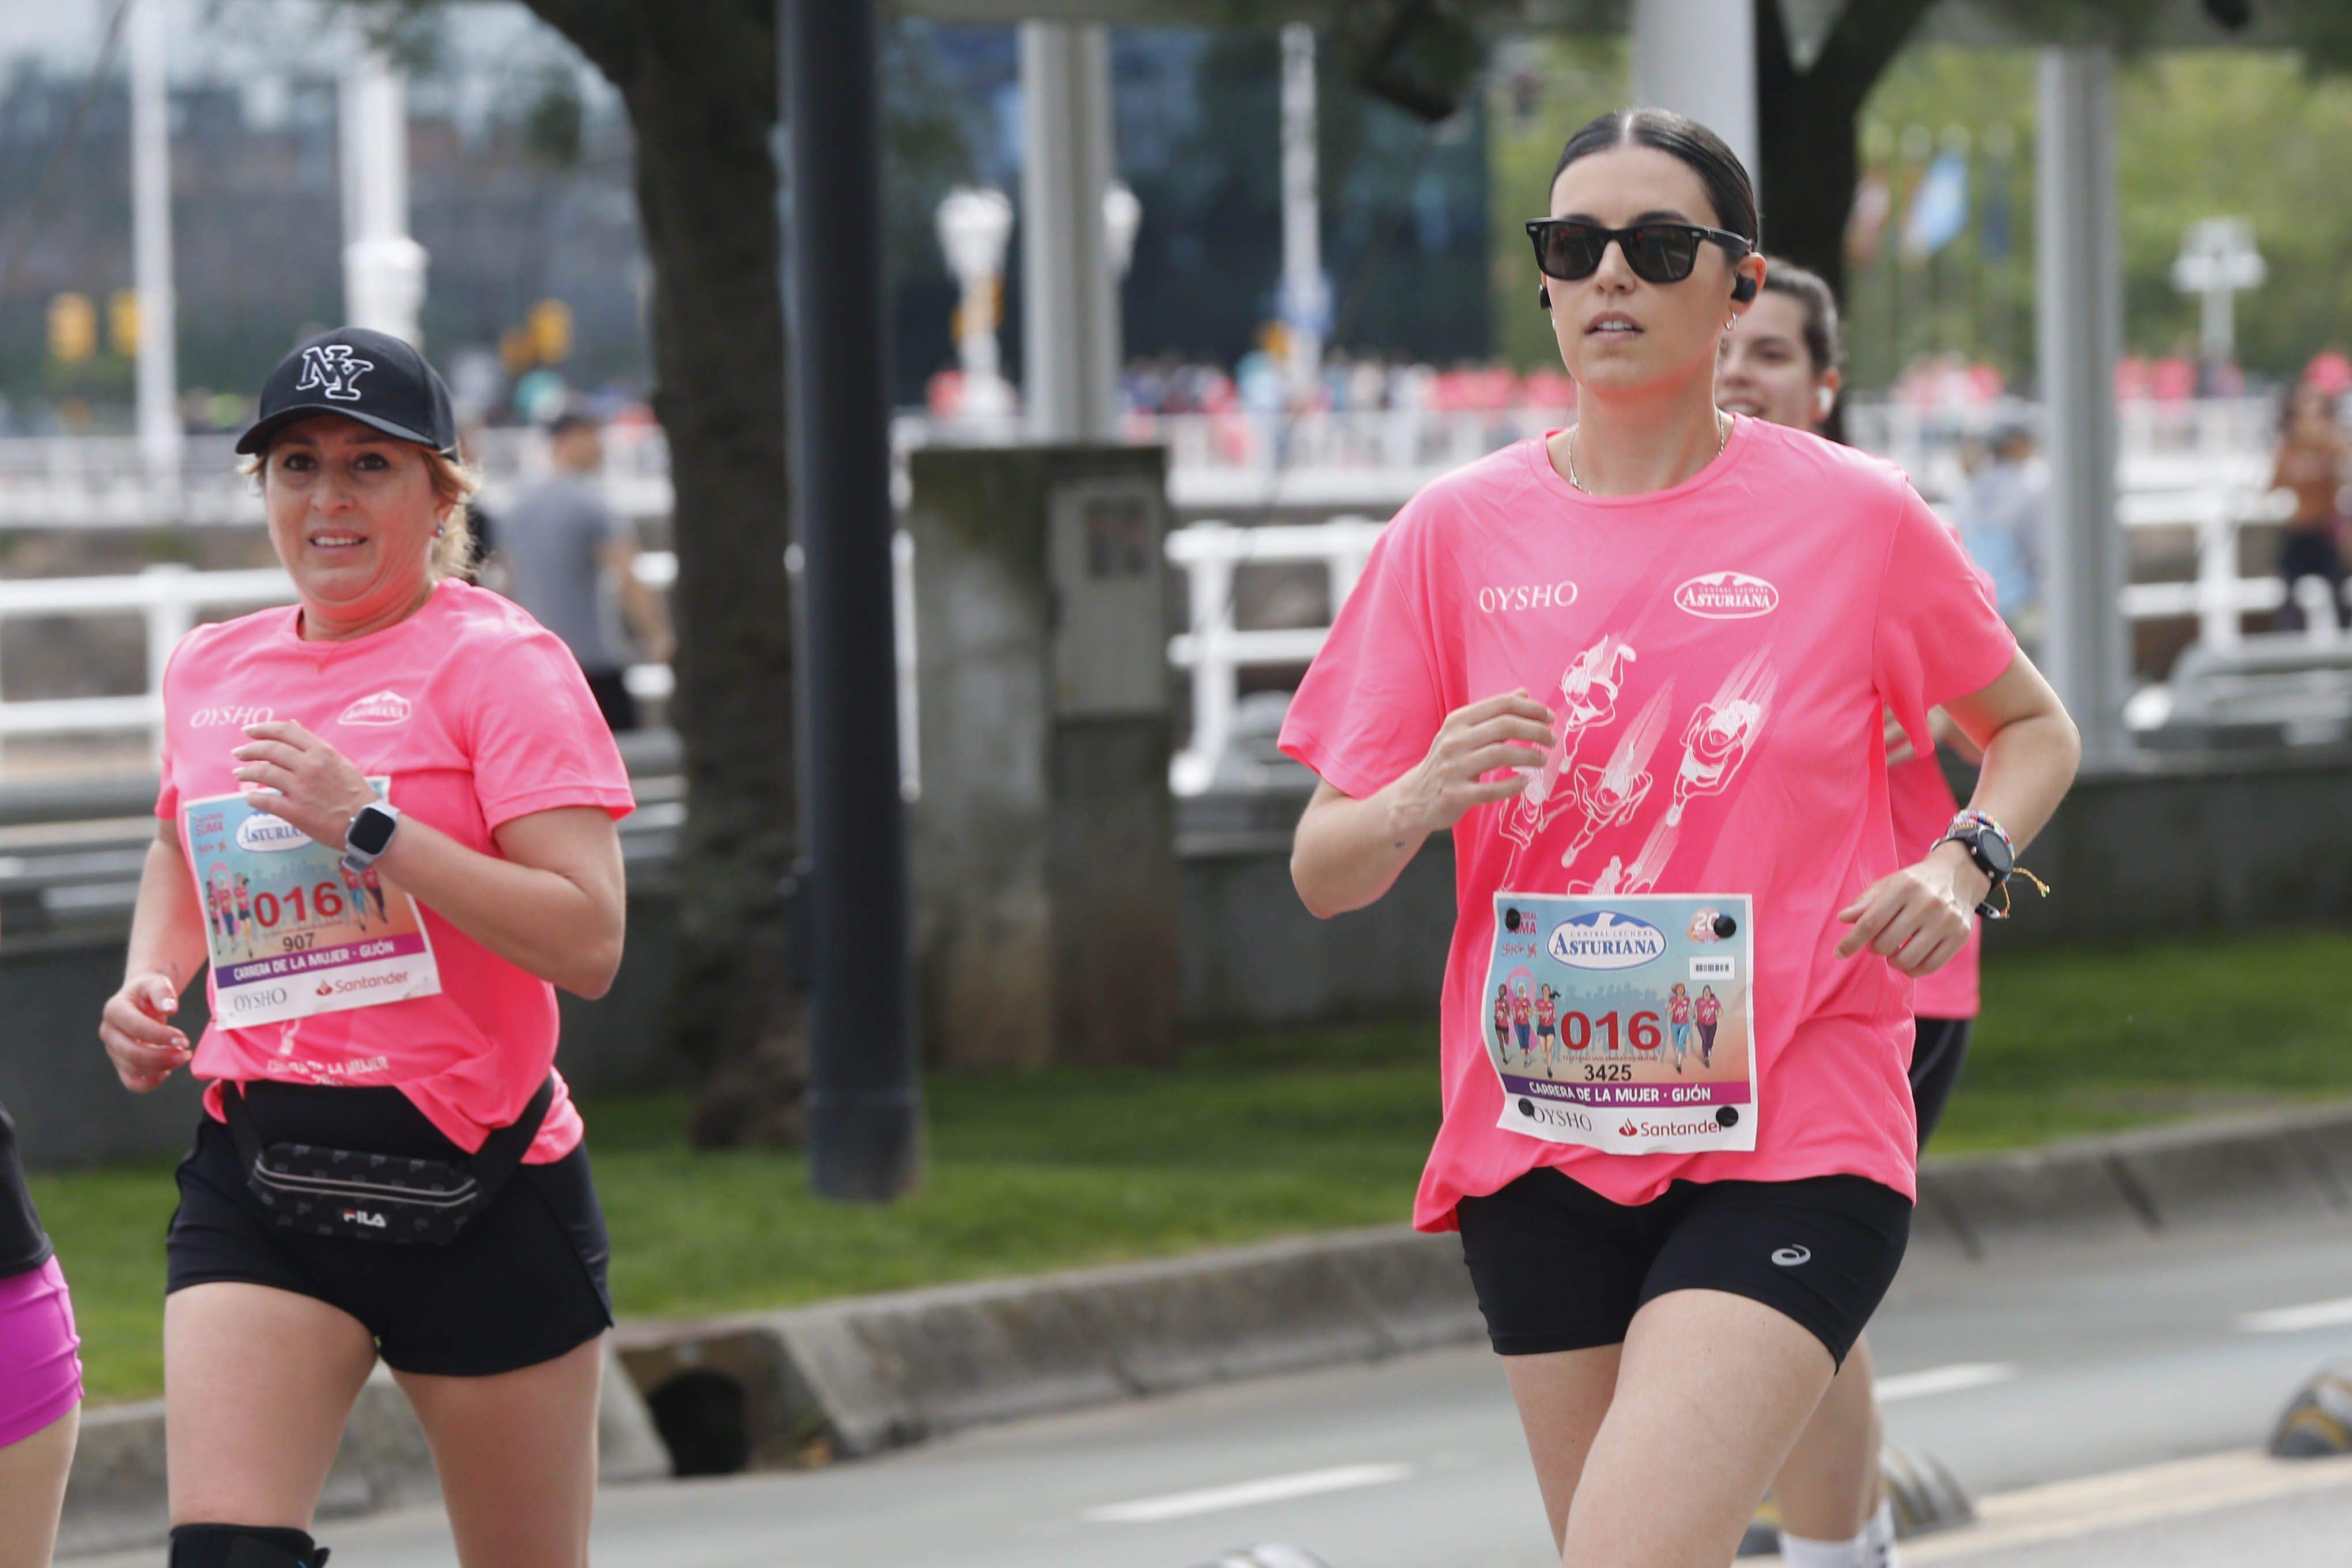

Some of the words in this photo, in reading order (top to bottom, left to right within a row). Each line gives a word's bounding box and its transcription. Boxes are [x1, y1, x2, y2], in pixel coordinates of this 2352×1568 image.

[296, 345, 374, 400] NY
[1479, 580, 1578, 614] OYSHO
[1676, 587, 1771, 609] ASTURIANA
[190, 706, 273, 728] OYSHO
[254, 881, 343, 928] 016
[283, 932, 315, 951] 907
[1554, 932, 1658, 955] ASTURIANA
[233, 962, 271, 981] CARRERA
[272, 958, 287, 973] DE
[290, 953, 307, 969] LA
[308, 948, 350, 966] MUJER
[359, 939, 395, 958] GIJÓN
[335, 971, 409, 994] Santander
[233, 987, 287, 1012] OYSHO
[1561, 1011, 1662, 1051] 016
[1584, 1064, 1632, 1082] 3425
[1529, 1082, 1575, 1100] CARRERA
[1578, 1087, 1591, 1102] DE
[1595, 1087, 1611, 1102] LA
[1615, 1087, 1659, 1102] MUJER
[1671, 1083, 1711, 1103] GIJÓN
[1532, 1105, 1592, 1132] OYSHO
[343, 1208, 387, 1228] FILA
